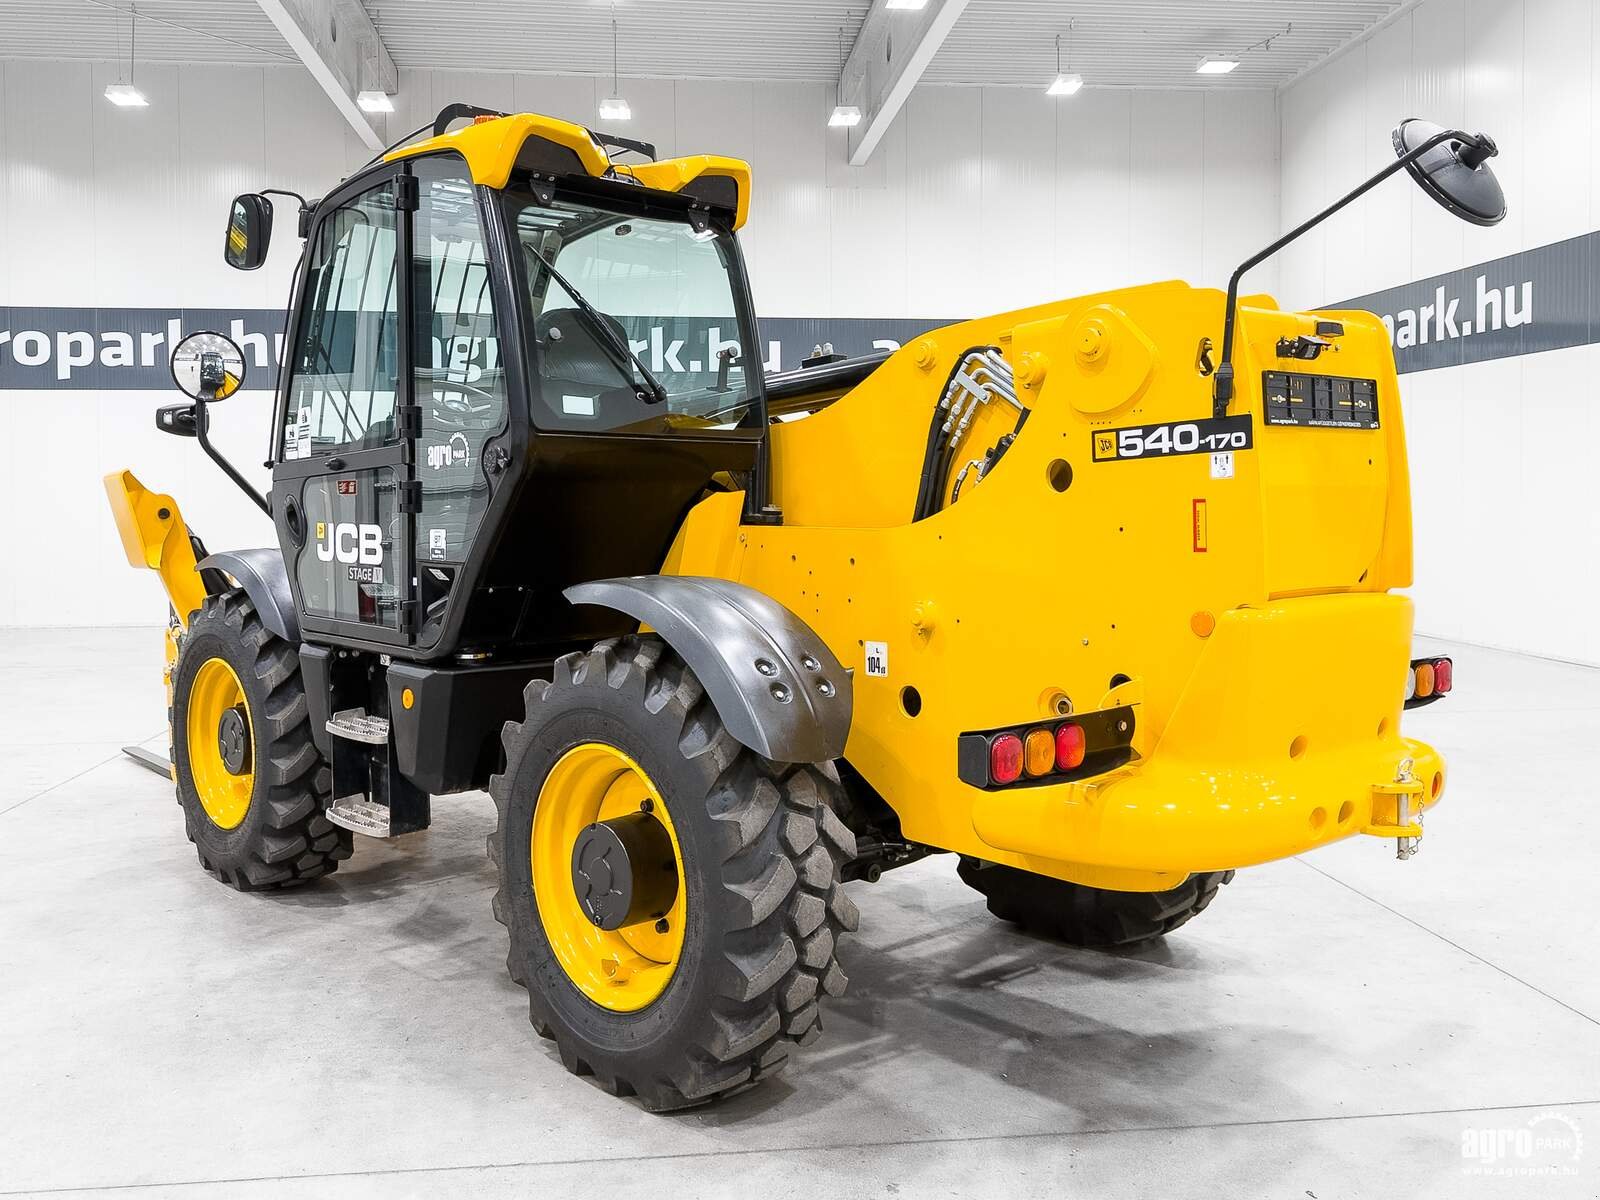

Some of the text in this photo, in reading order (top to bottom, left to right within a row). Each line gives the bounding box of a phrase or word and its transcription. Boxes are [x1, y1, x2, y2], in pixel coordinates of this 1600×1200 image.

[1118, 423, 1247, 457] 540-170
[427, 445, 452, 470] agro
[316, 522, 384, 565] JCB
[349, 567, 372, 581] STAGE
[868, 656, 880, 673] 104
